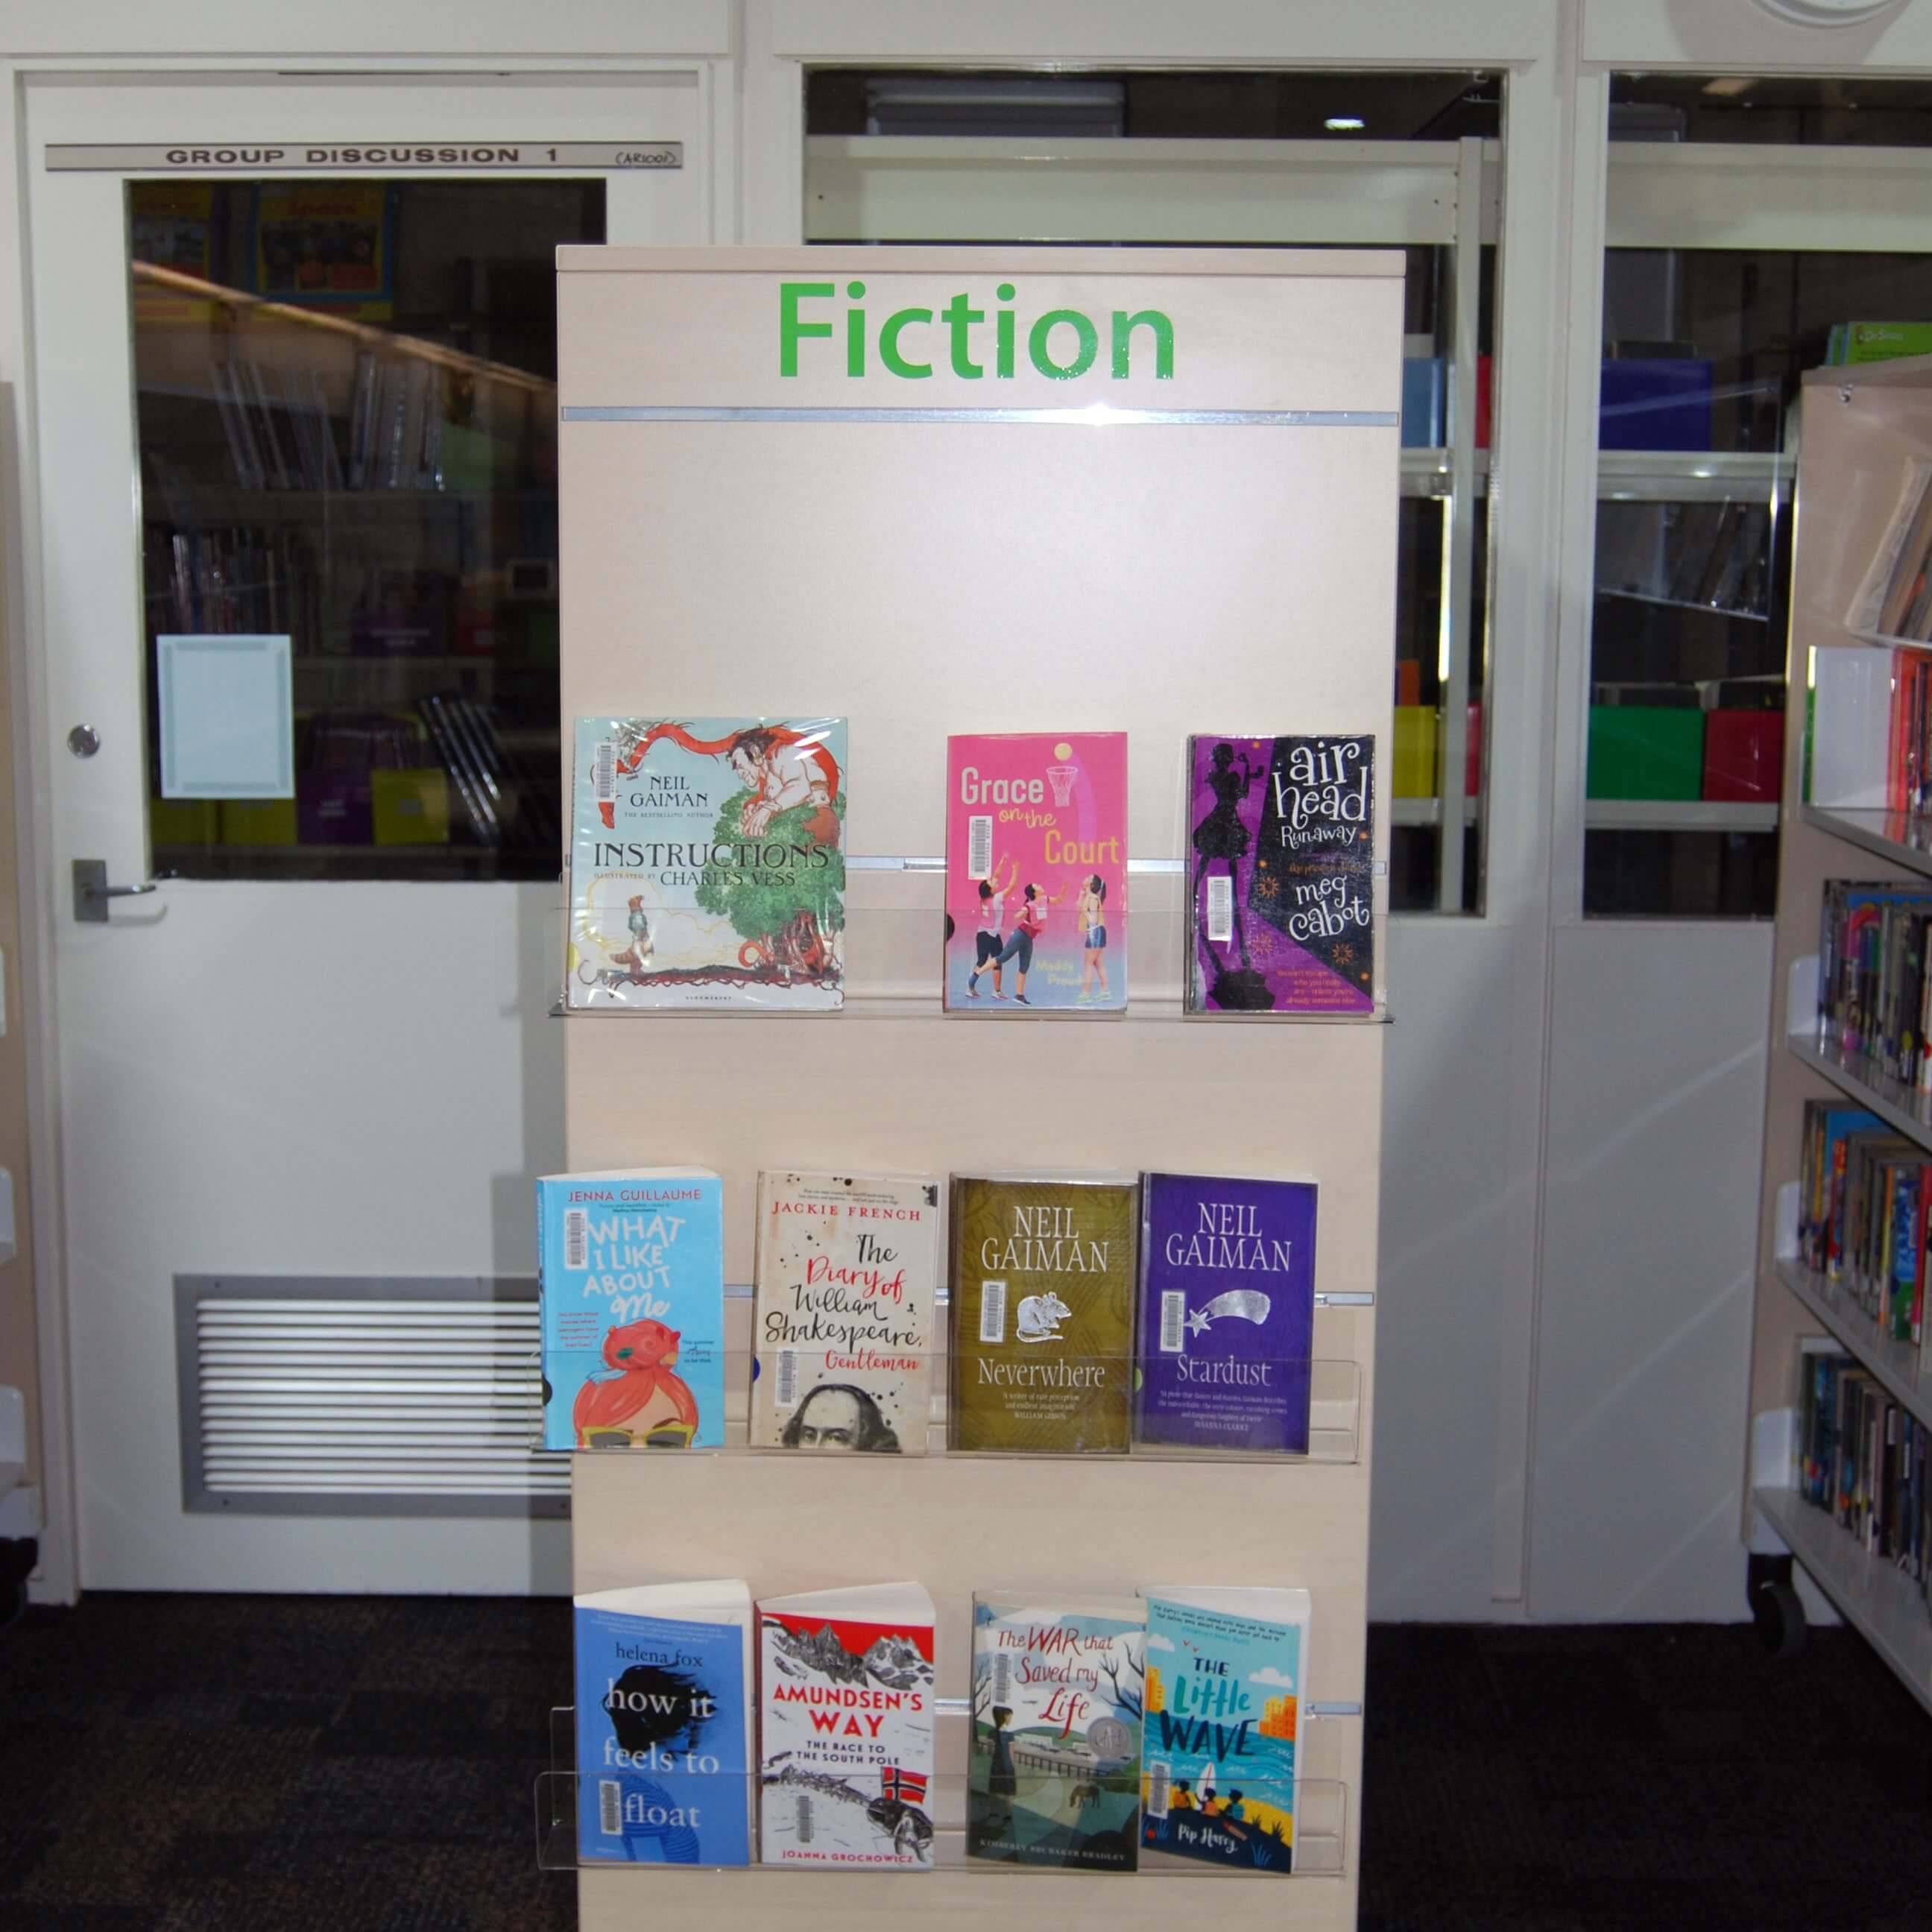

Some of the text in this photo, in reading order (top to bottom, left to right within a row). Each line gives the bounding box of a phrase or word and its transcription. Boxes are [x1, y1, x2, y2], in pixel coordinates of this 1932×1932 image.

[166, 148, 557, 163] GROUP DISCUSSION 1
[780, 280, 1175, 379] Fiction
[1289, 742, 1360, 786] air
[649, 775, 691, 791] NEIL
[960, 767, 1044, 805] Grace
[1272, 766, 1368, 830] head
[630, 792, 709, 808] GAIMAN
[999, 807, 1057, 829] on the
[1044, 830, 1120, 865] Court
[1281, 825, 1357, 850] Runaway
[593, 842, 830, 868] INSTRUCTIONS
[660, 871, 744, 886] CHARLES
[751, 871, 796, 887] VESS
[1295, 875, 1348, 908] meg
[1289, 895, 1370, 941] cabot
[568, 1189, 701, 1202] JENNA GUILLAUME
[771, 1201, 921, 1222] JACKIE FRENCH
[587, 1215, 686, 1249] WHAT
[1013, 1205, 1080, 1239] NEIL
[1197, 1202, 1263, 1237] NEIL
[610, 1243, 664, 1270] LIKE
[855, 1234, 899, 1264] The
[980, 1237, 1110, 1273] GAIMAN
[1165, 1233, 1292, 1272] GAIMAN
[583, 1266, 671, 1298] ABOUT
[806, 1255, 907, 1304] Diary of
[789, 1284, 888, 1321] William
[765, 1310, 923, 1354] Shakespeare,
[824, 1348, 920, 1371] Gentleman
[977, 1357, 1105, 1388] Neverwhere
[1176, 1353, 1272, 1387] Stardust
[615, 1641, 704, 1667] helena fox
[997, 1625, 1114, 1657] The WAR that
[1014, 1655, 1073, 1685] Saved
[1076, 1671, 1099, 1693] my
[1193, 1656, 1231, 1677] THE
[606, 1677, 713, 1718] how it
[772, 1683, 924, 1712] AMUNDSEN'S
[1172, 1675, 1251, 1719] Little
[808, 1709, 885, 1738] WAY
[1038, 1687, 1090, 1741] Life
[806, 1740, 886, 1754] THE RACE TO
[1159, 1708, 1260, 1764] WAVE
[602, 1735, 720, 1775] feels to
[797, 1751, 900, 1766] THE SOUTH POLE
[623, 1792, 701, 1828] float
[1177, 1822, 1239, 1854] Pip Harry
[782, 1849, 914, 1863] JOANNA GROCHOWICZ
